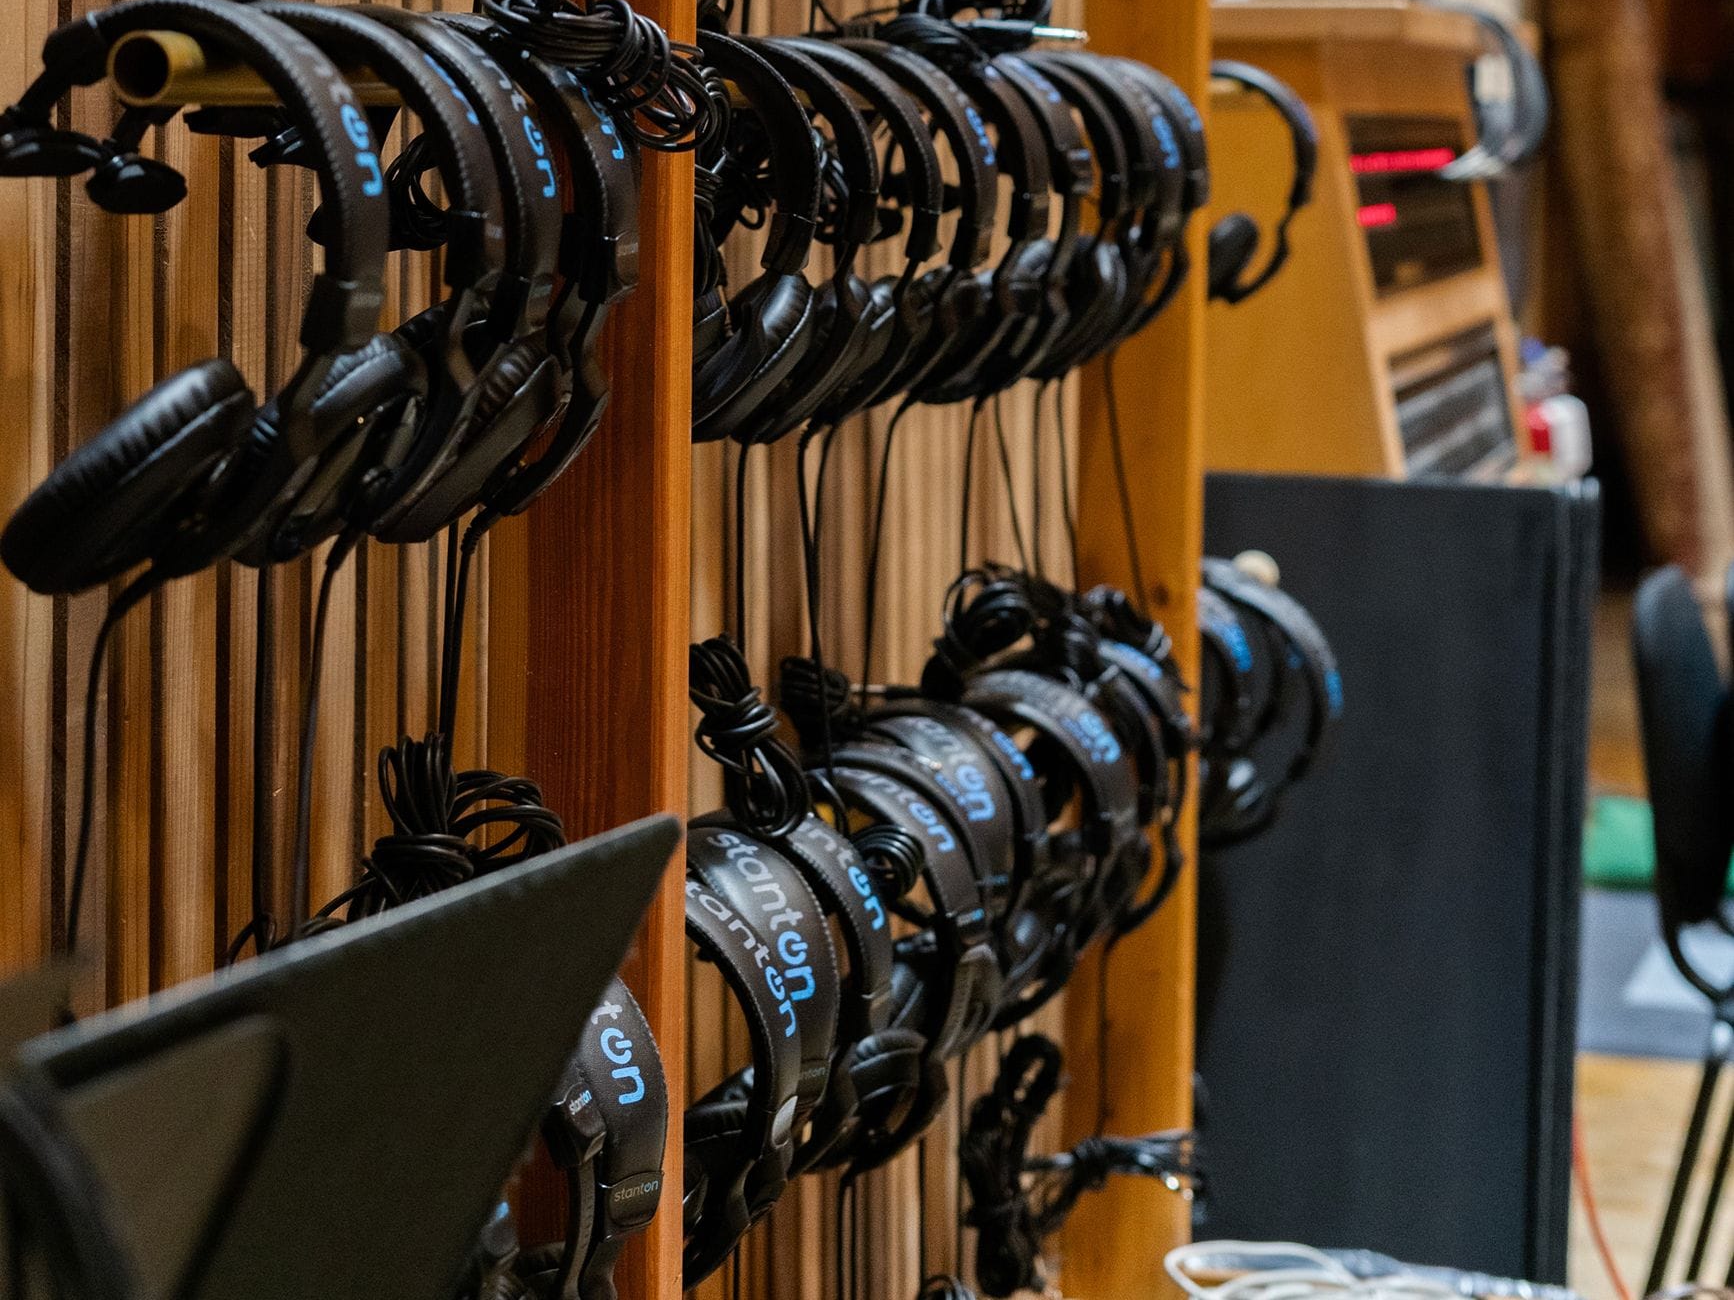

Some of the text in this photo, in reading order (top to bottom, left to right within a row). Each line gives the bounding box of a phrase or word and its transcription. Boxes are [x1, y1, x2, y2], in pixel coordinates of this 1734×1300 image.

[706, 832, 816, 1002] stanton
[800, 821, 886, 931] nton
[685, 880, 797, 1038] tanton
[613, 1180, 659, 1202] stanton
